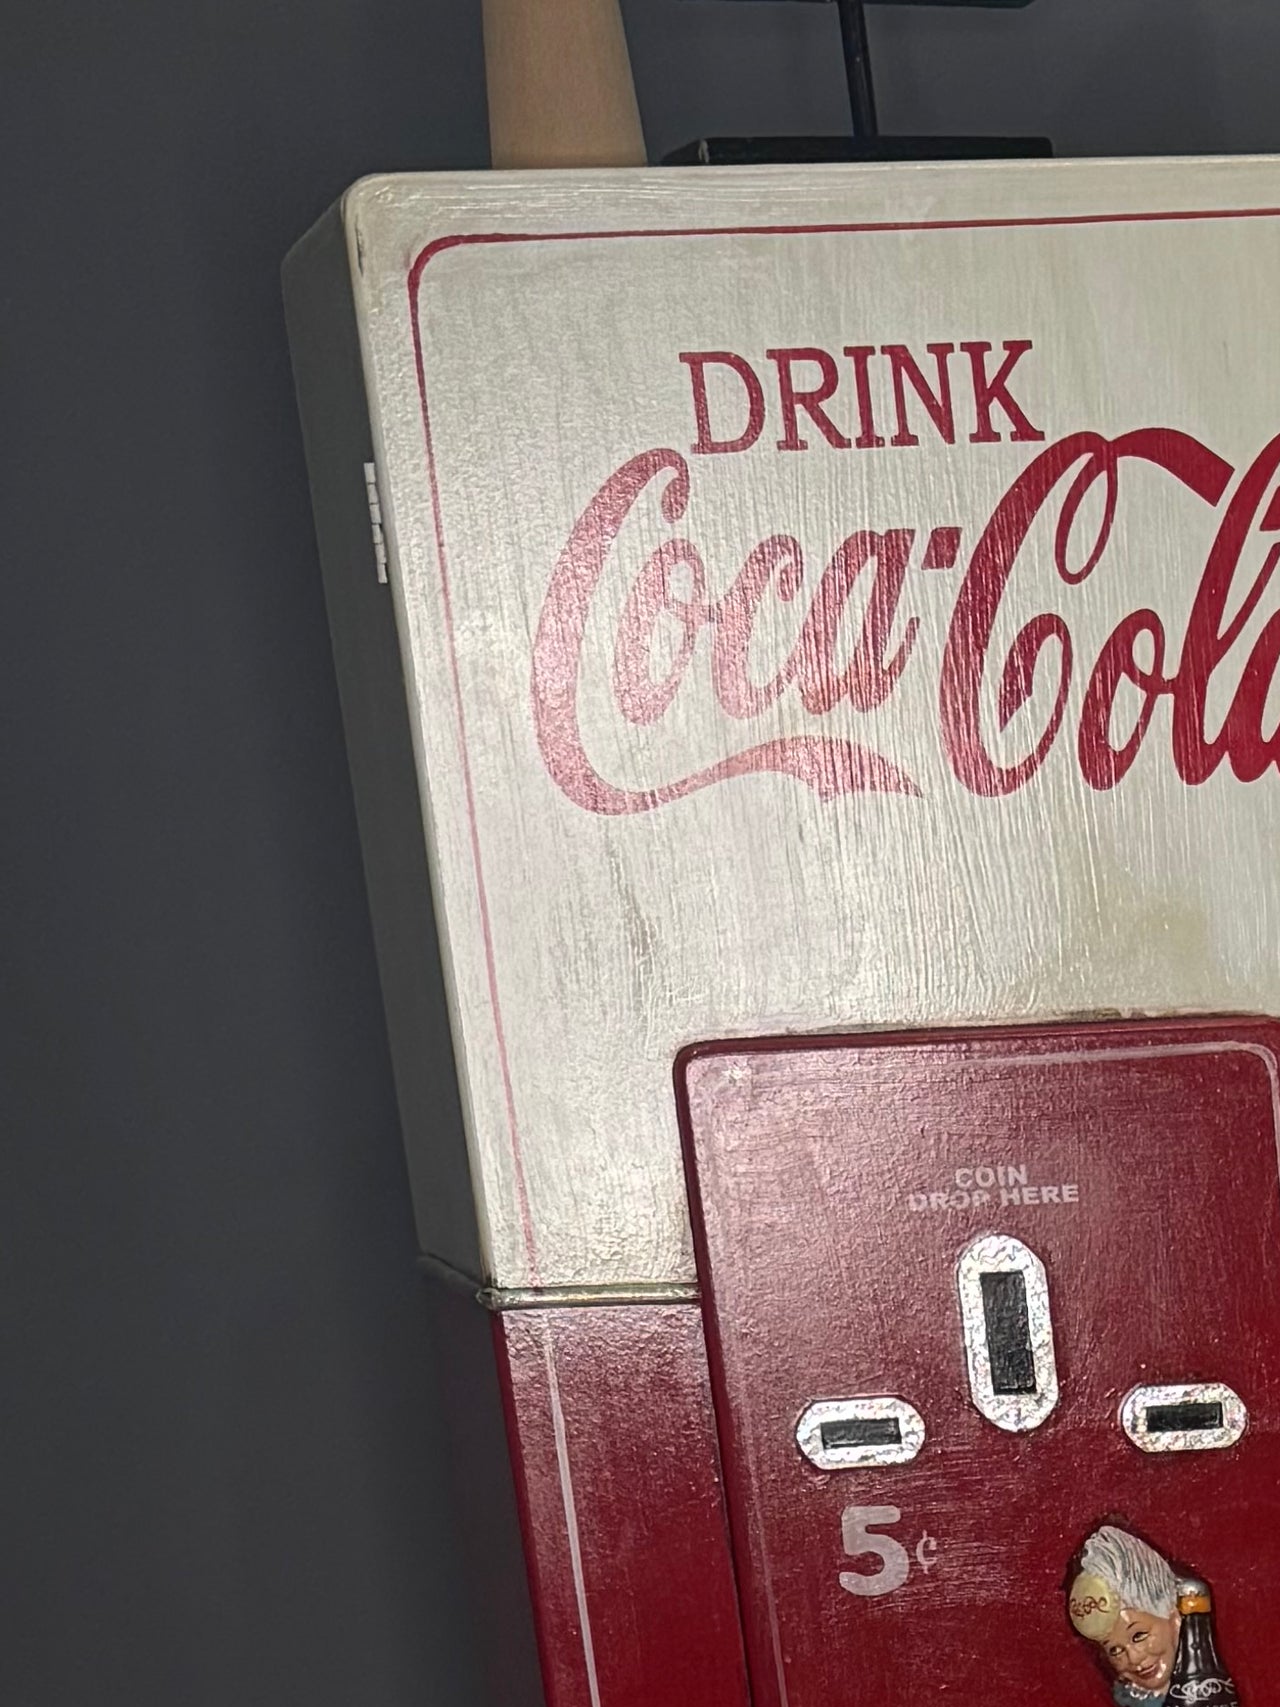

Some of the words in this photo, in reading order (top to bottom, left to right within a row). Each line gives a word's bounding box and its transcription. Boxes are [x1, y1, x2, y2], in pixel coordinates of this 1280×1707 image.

[679, 339, 1046, 455] DRINK
[955, 1164, 1028, 1189] COIN
[907, 1190, 991, 1212] DROP
[1000, 1184, 1080, 1207] HERE
